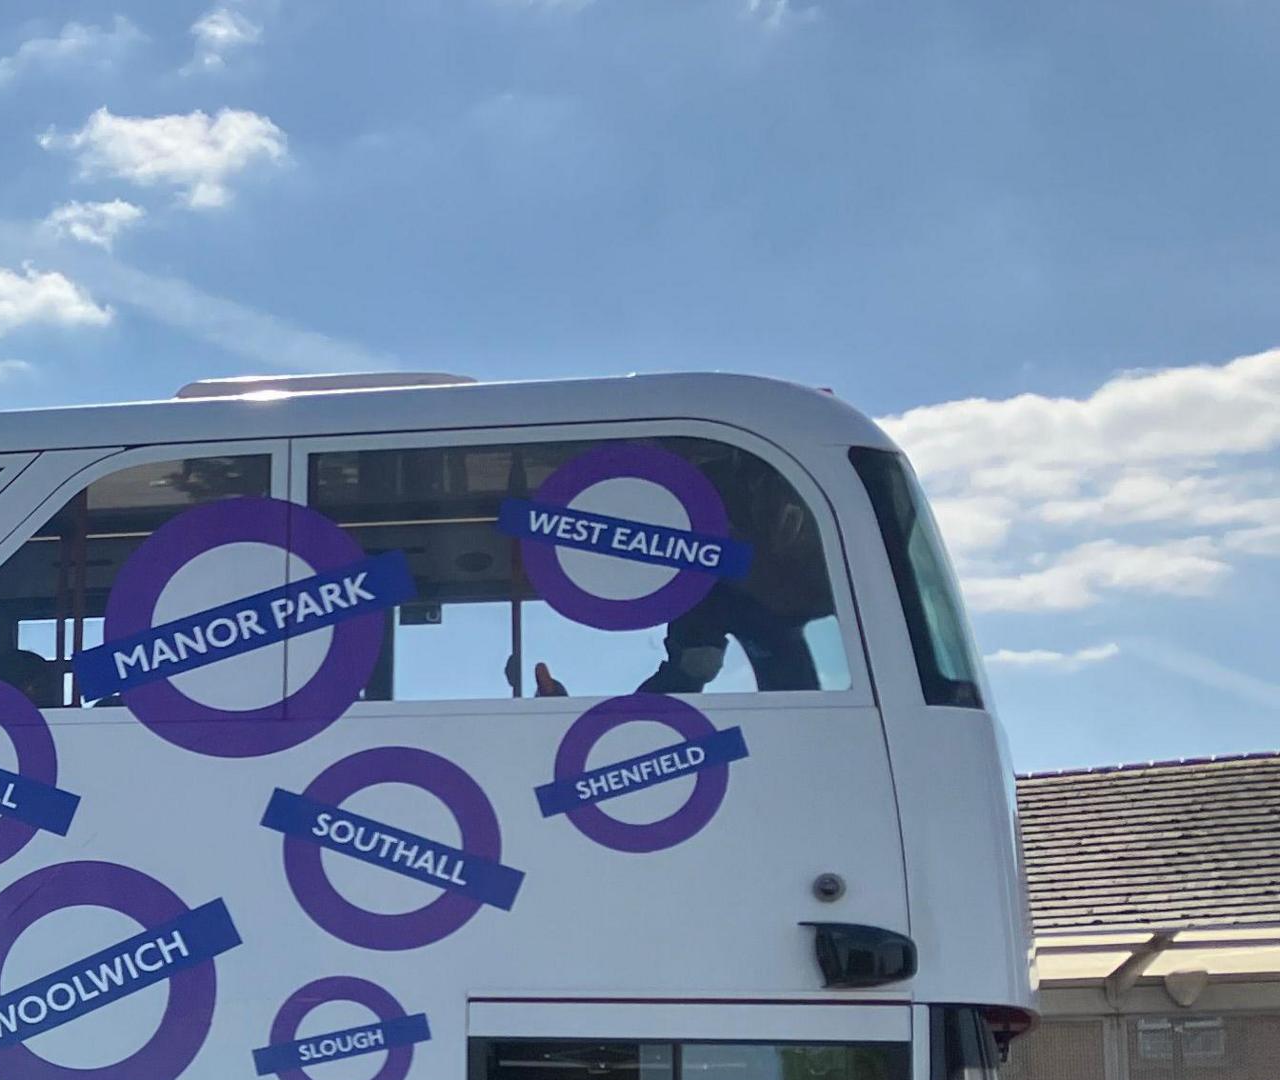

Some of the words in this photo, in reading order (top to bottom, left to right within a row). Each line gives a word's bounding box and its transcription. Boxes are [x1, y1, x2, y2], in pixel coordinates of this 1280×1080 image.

[529, 511, 607, 546] WEST
[613, 527, 721, 568] EALING
[114, 608, 265, 679] MANOR
[272, 572, 375, 629] PARK
[576, 747, 705, 801] SHENFIELD
[312, 813, 467, 886] SOUTHALL
[298, 1029, 384, 1061] SLOUGH
